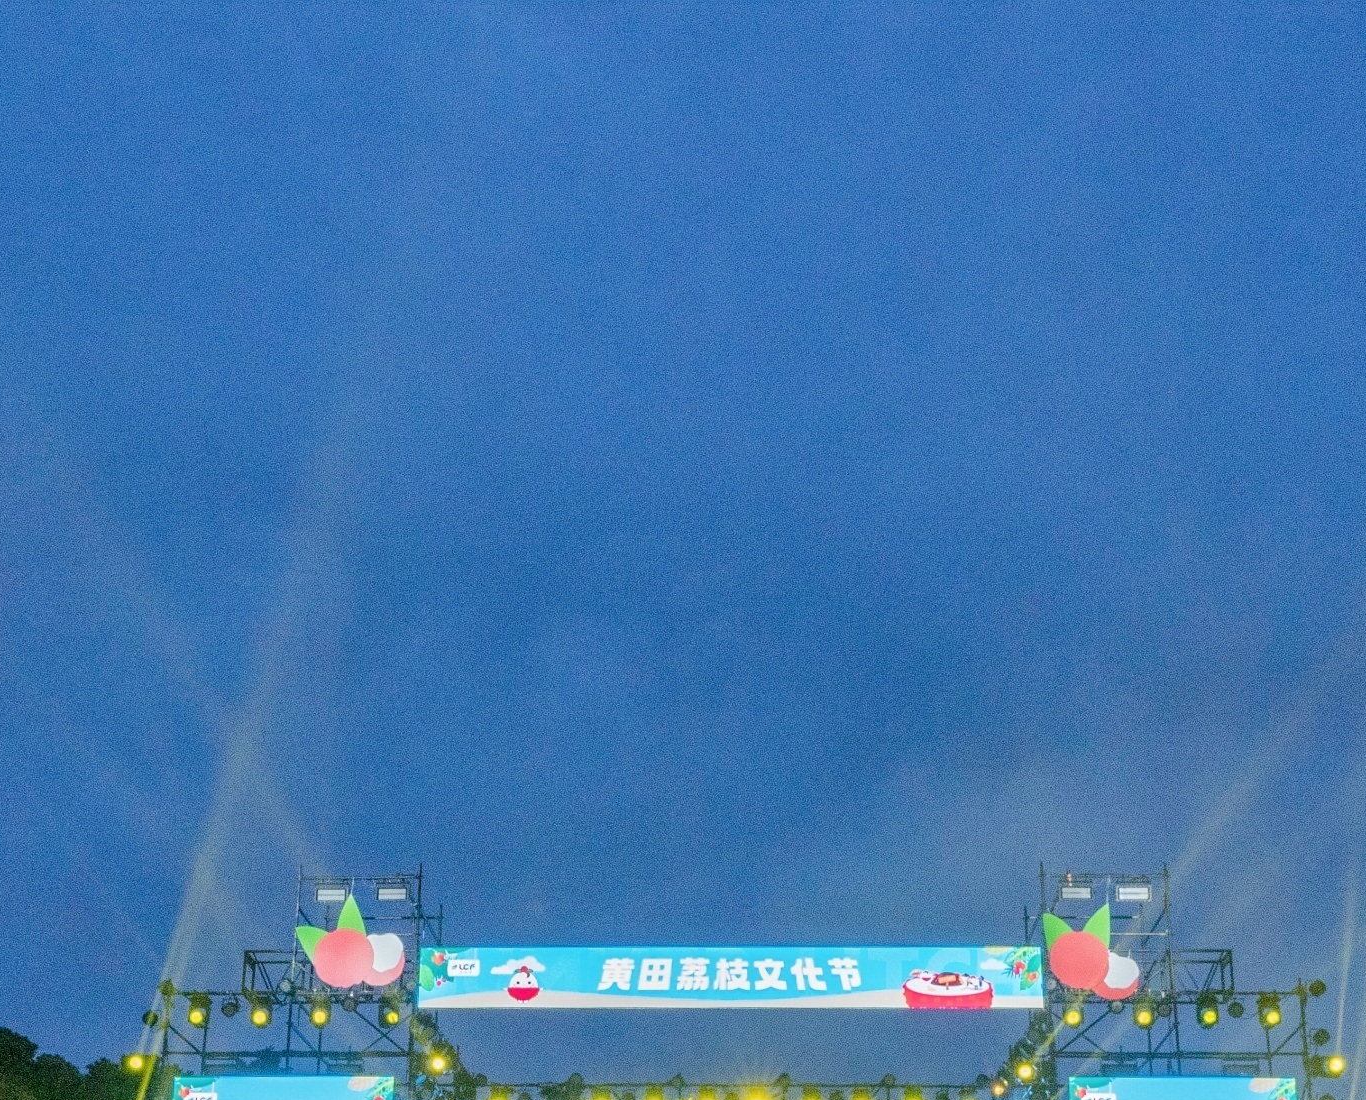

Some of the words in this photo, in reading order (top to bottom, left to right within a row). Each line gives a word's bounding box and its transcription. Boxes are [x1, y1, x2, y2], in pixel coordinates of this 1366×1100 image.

[597, 957, 863, 991] 黄田荔枝文化节
